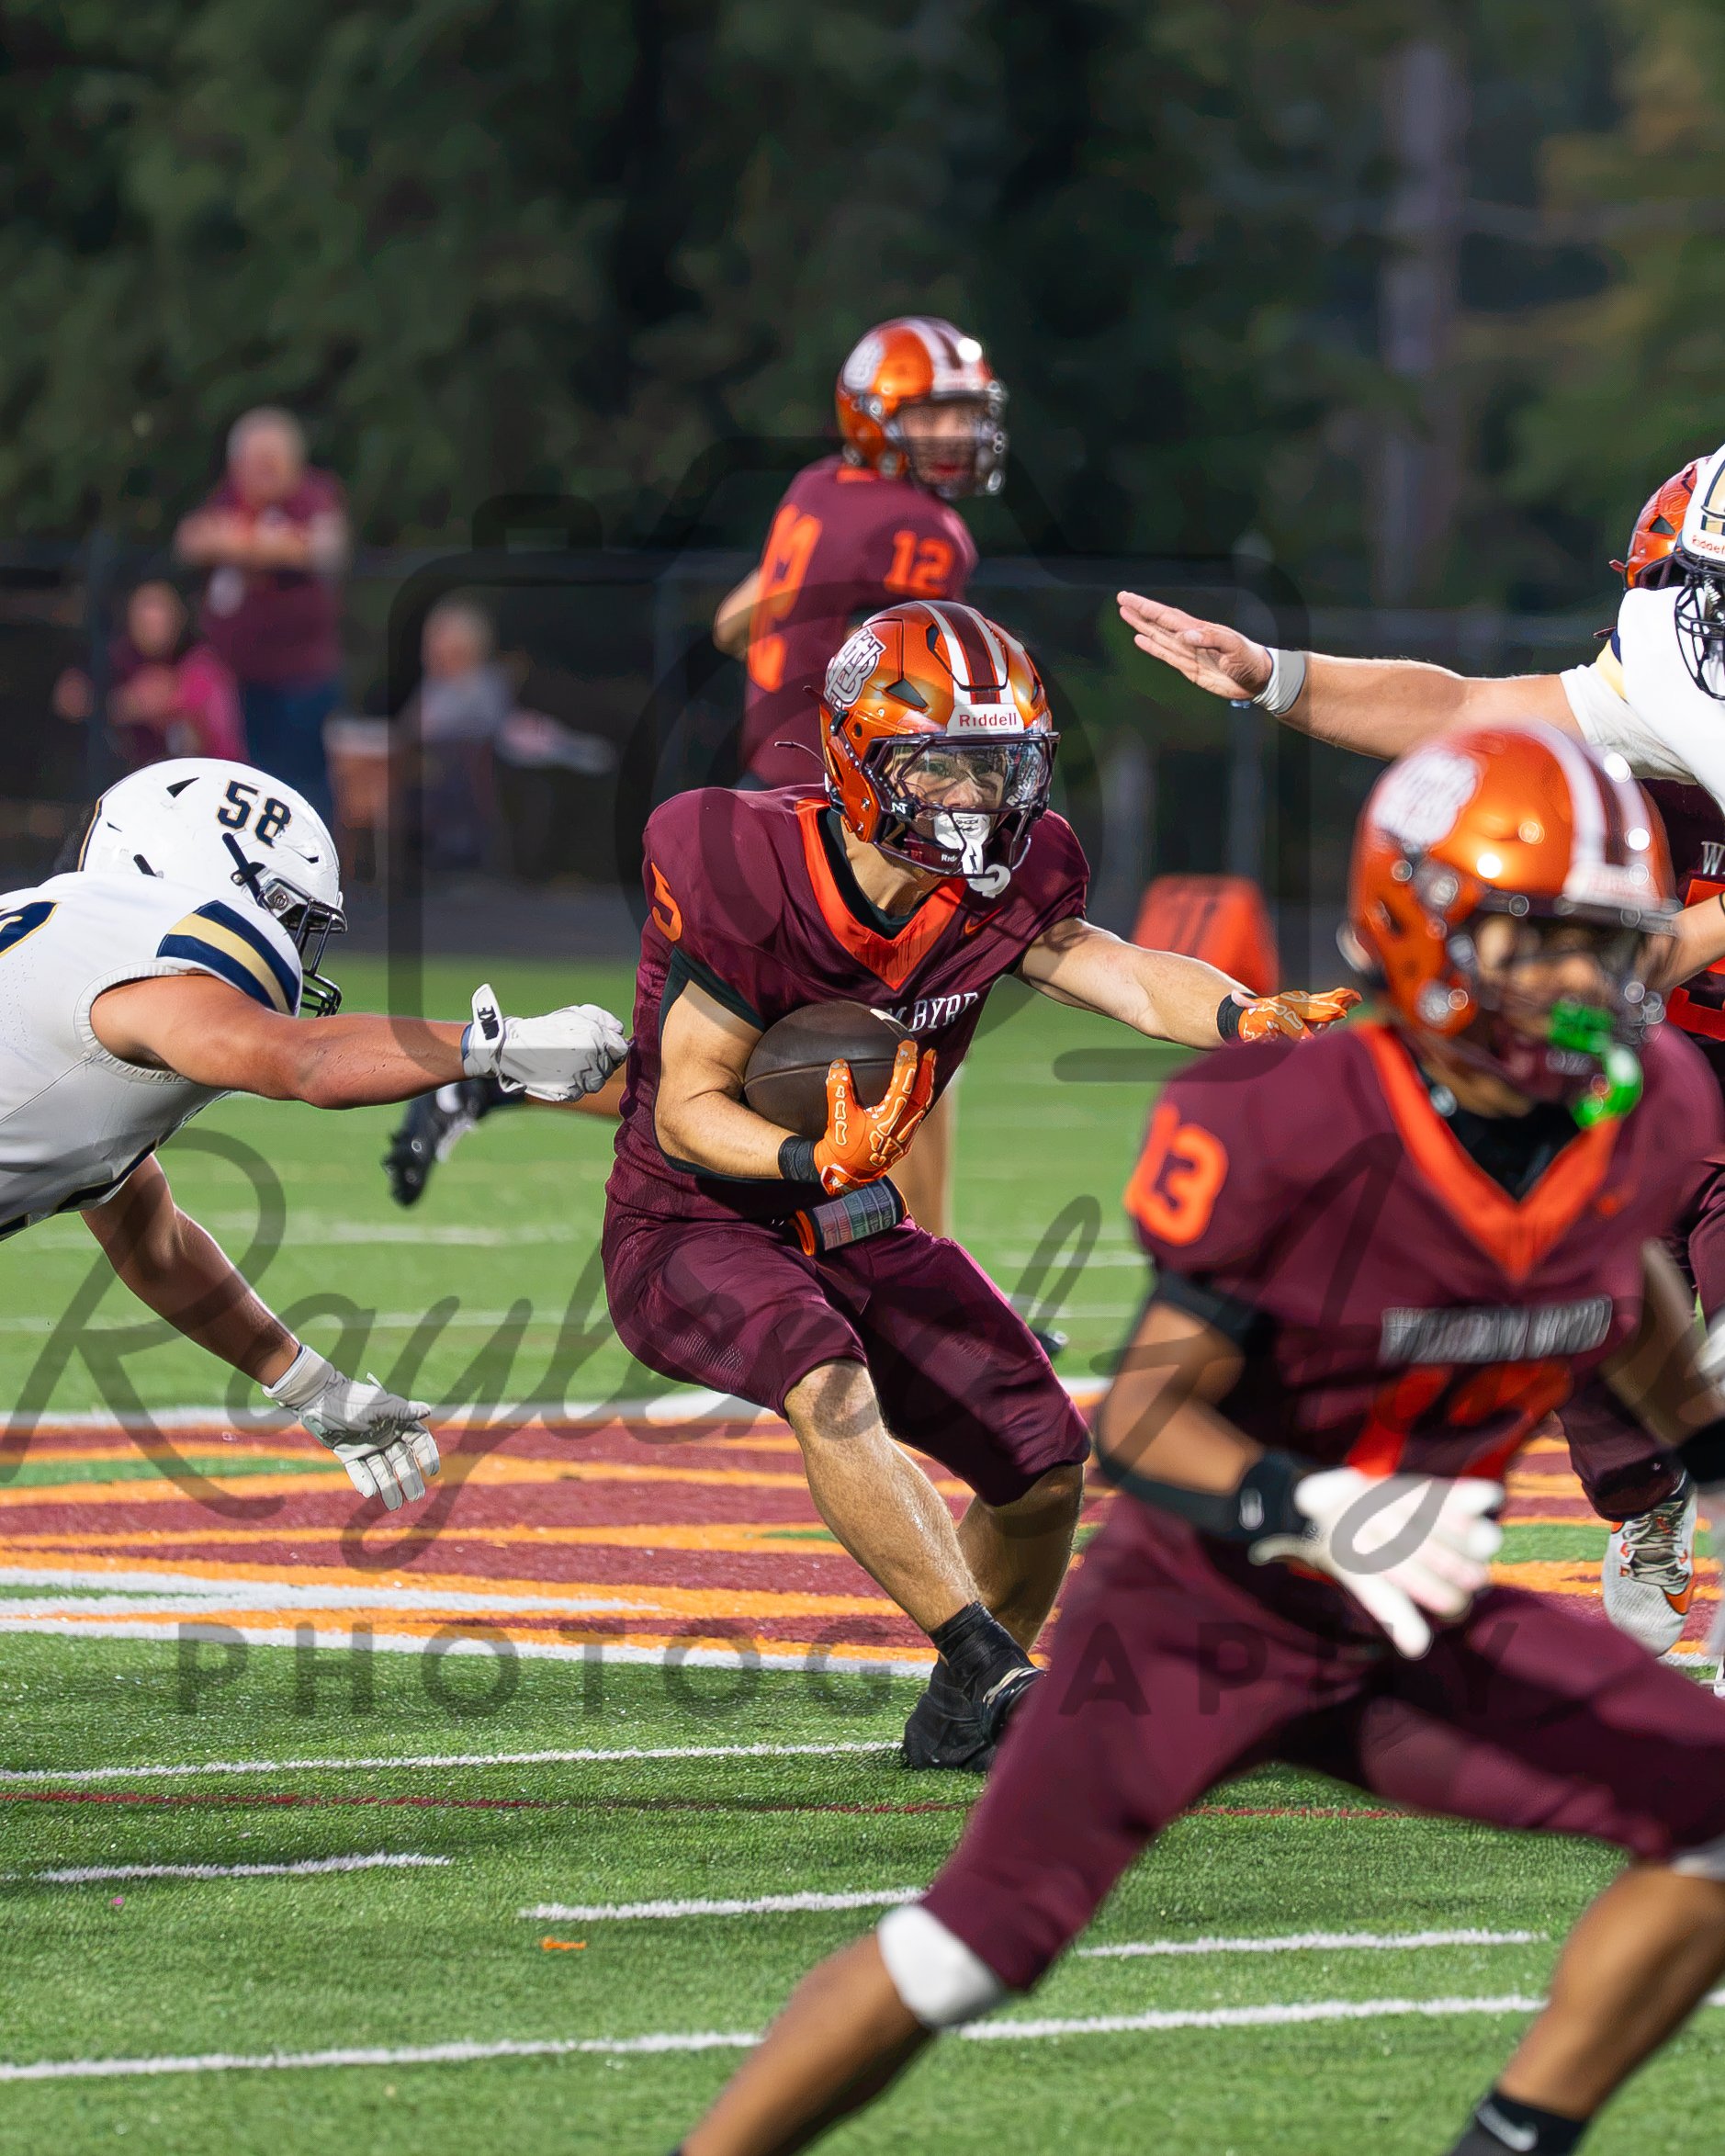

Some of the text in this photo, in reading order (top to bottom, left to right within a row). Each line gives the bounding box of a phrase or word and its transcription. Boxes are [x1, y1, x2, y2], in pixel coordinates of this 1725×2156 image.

[884, 529, 955, 599] 12
[959, 713, 1017, 728] Riddell
[217, 780, 292, 848] 58
[651, 862, 682, 943] 5
[1123, 1101, 1229, 1247] 13
